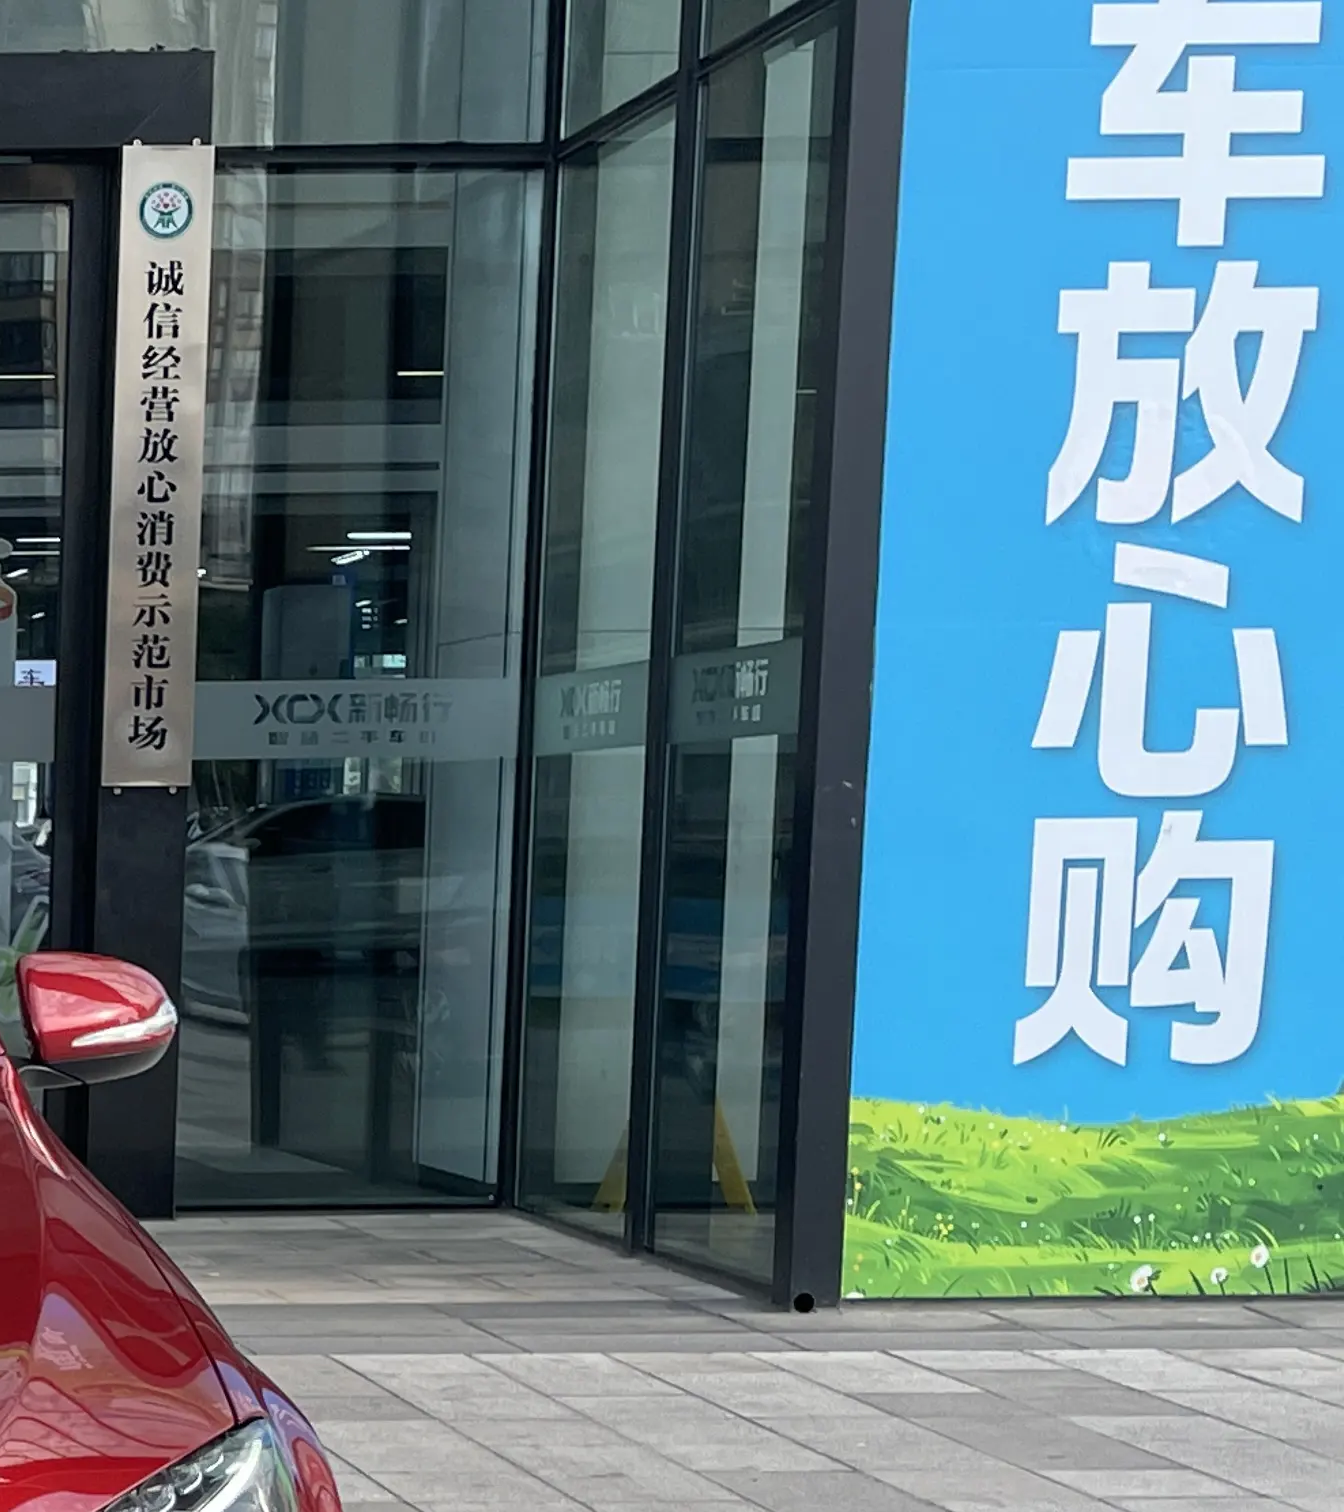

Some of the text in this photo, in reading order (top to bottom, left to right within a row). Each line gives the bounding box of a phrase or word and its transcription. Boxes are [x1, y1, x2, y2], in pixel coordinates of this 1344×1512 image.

[127, 260, 185, 751] 诚信经营放心消费示范市场
[1013, 0, 1326, 1068] 车放心购
